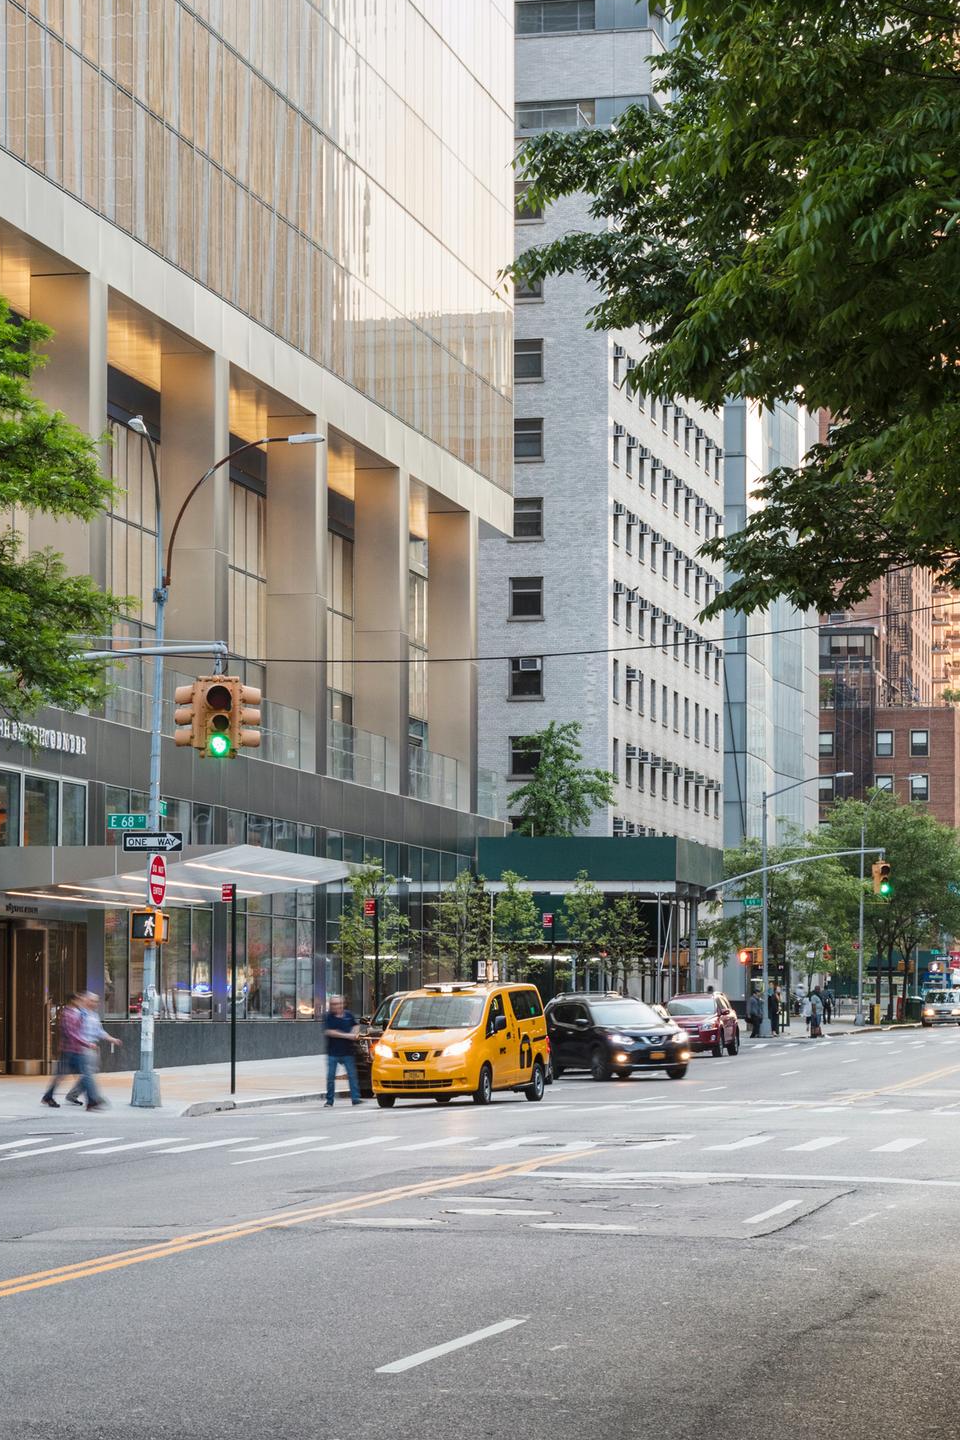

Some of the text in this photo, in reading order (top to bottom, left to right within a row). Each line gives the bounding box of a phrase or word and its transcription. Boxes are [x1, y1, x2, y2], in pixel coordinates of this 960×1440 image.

[111, 815, 117, 827] E
[121, 815, 134, 828] 68
[128, 838, 176, 846] ONE WAY
